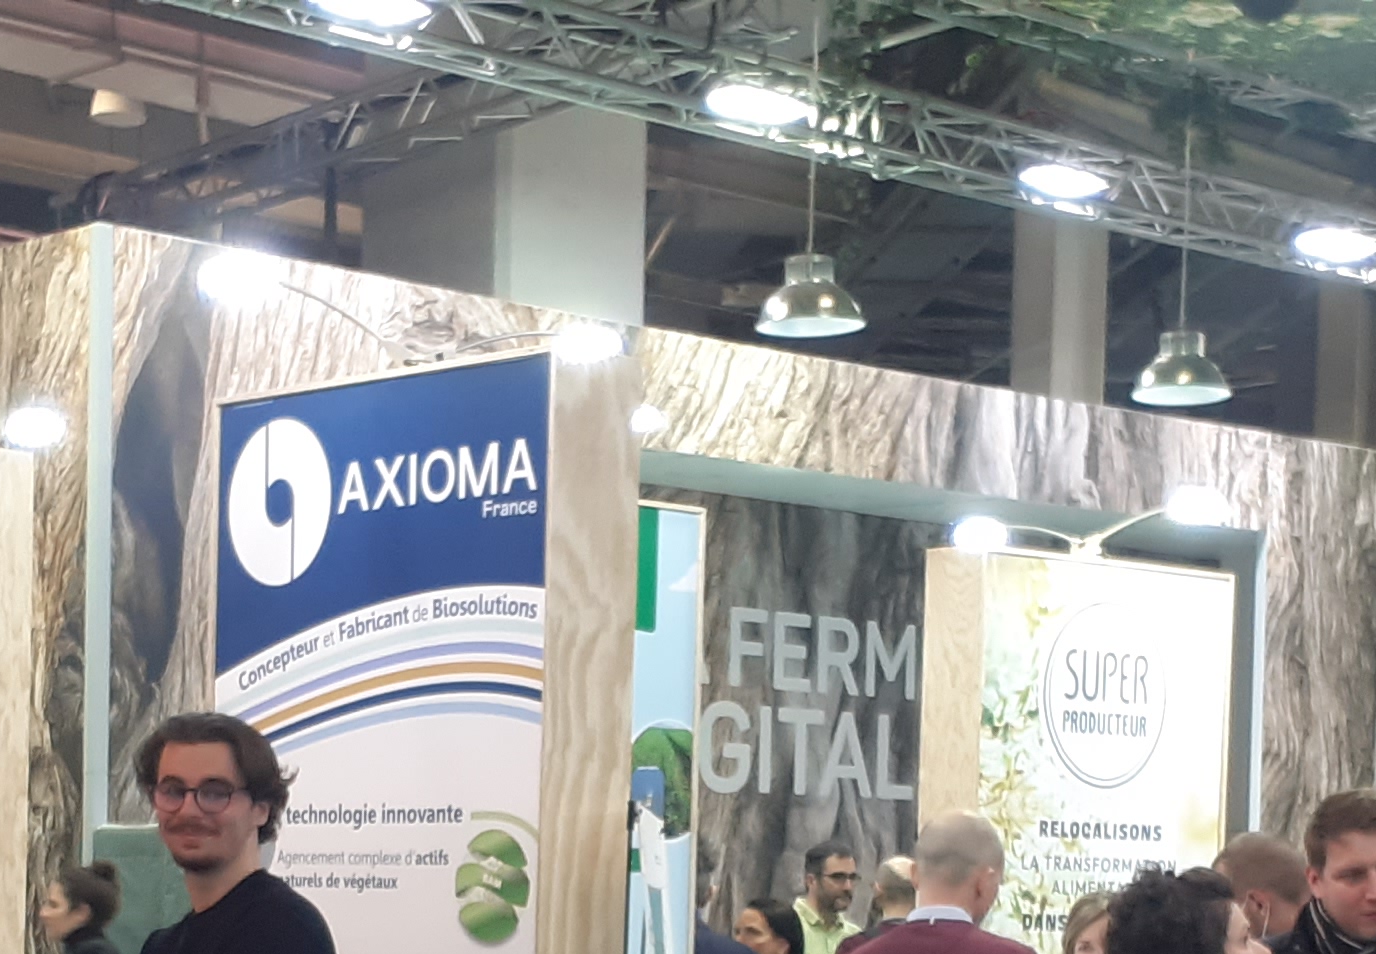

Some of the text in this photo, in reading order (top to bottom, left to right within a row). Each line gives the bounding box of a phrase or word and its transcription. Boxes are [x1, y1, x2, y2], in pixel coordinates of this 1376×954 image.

[337, 439, 538, 514] AXIOMA
[482, 500, 538, 519] France
[238, 594, 538, 691] Concepteur et Fabricant de Biosolutions
[1064, 649, 1149, 704] SUPER
[1063, 710, 1146, 737] PRODUCTEUR
[286, 803, 463, 830] technologie innovante
[1039, 820, 1162, 841] RELOCALISONS
[277, 848, 450, 867] Agencement complexe d'actifs
[1021, 856, 1039, 870] LA
[326, 872, 341, 888] de
[344, 874, 398, 893] végétaux
